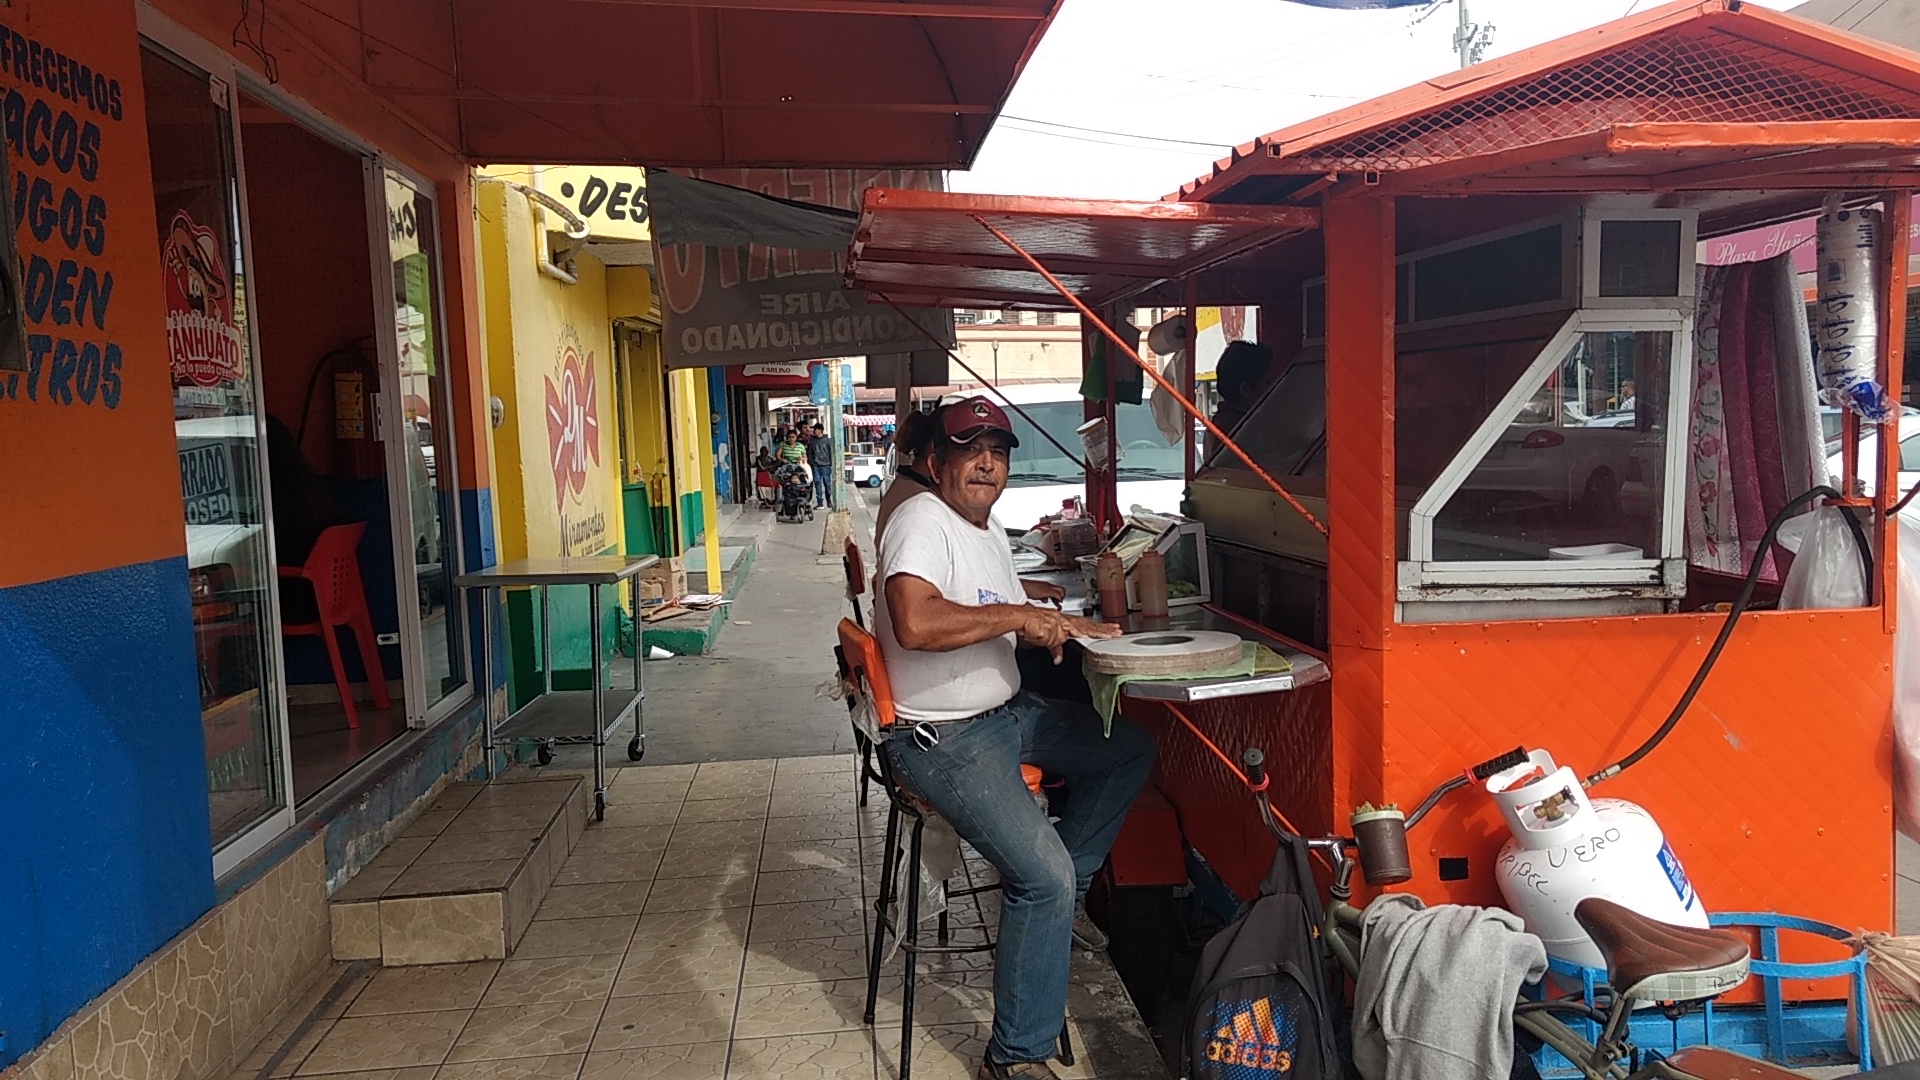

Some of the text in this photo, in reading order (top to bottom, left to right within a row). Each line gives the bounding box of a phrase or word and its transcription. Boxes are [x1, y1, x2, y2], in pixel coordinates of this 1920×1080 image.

[0, 86, 100, 182] ACOS
[1714, 243, 1757, 265] Plaza
[19, 253, 113, 330] DEN
[167, 327, 239, 368] TANHUATO
[187, 360, 194, 372] lo
[195, 362, 215, 375] puedo
[0, 334, 122, 409] TROS
[1205, 1038, 1291, 1073] adidas
